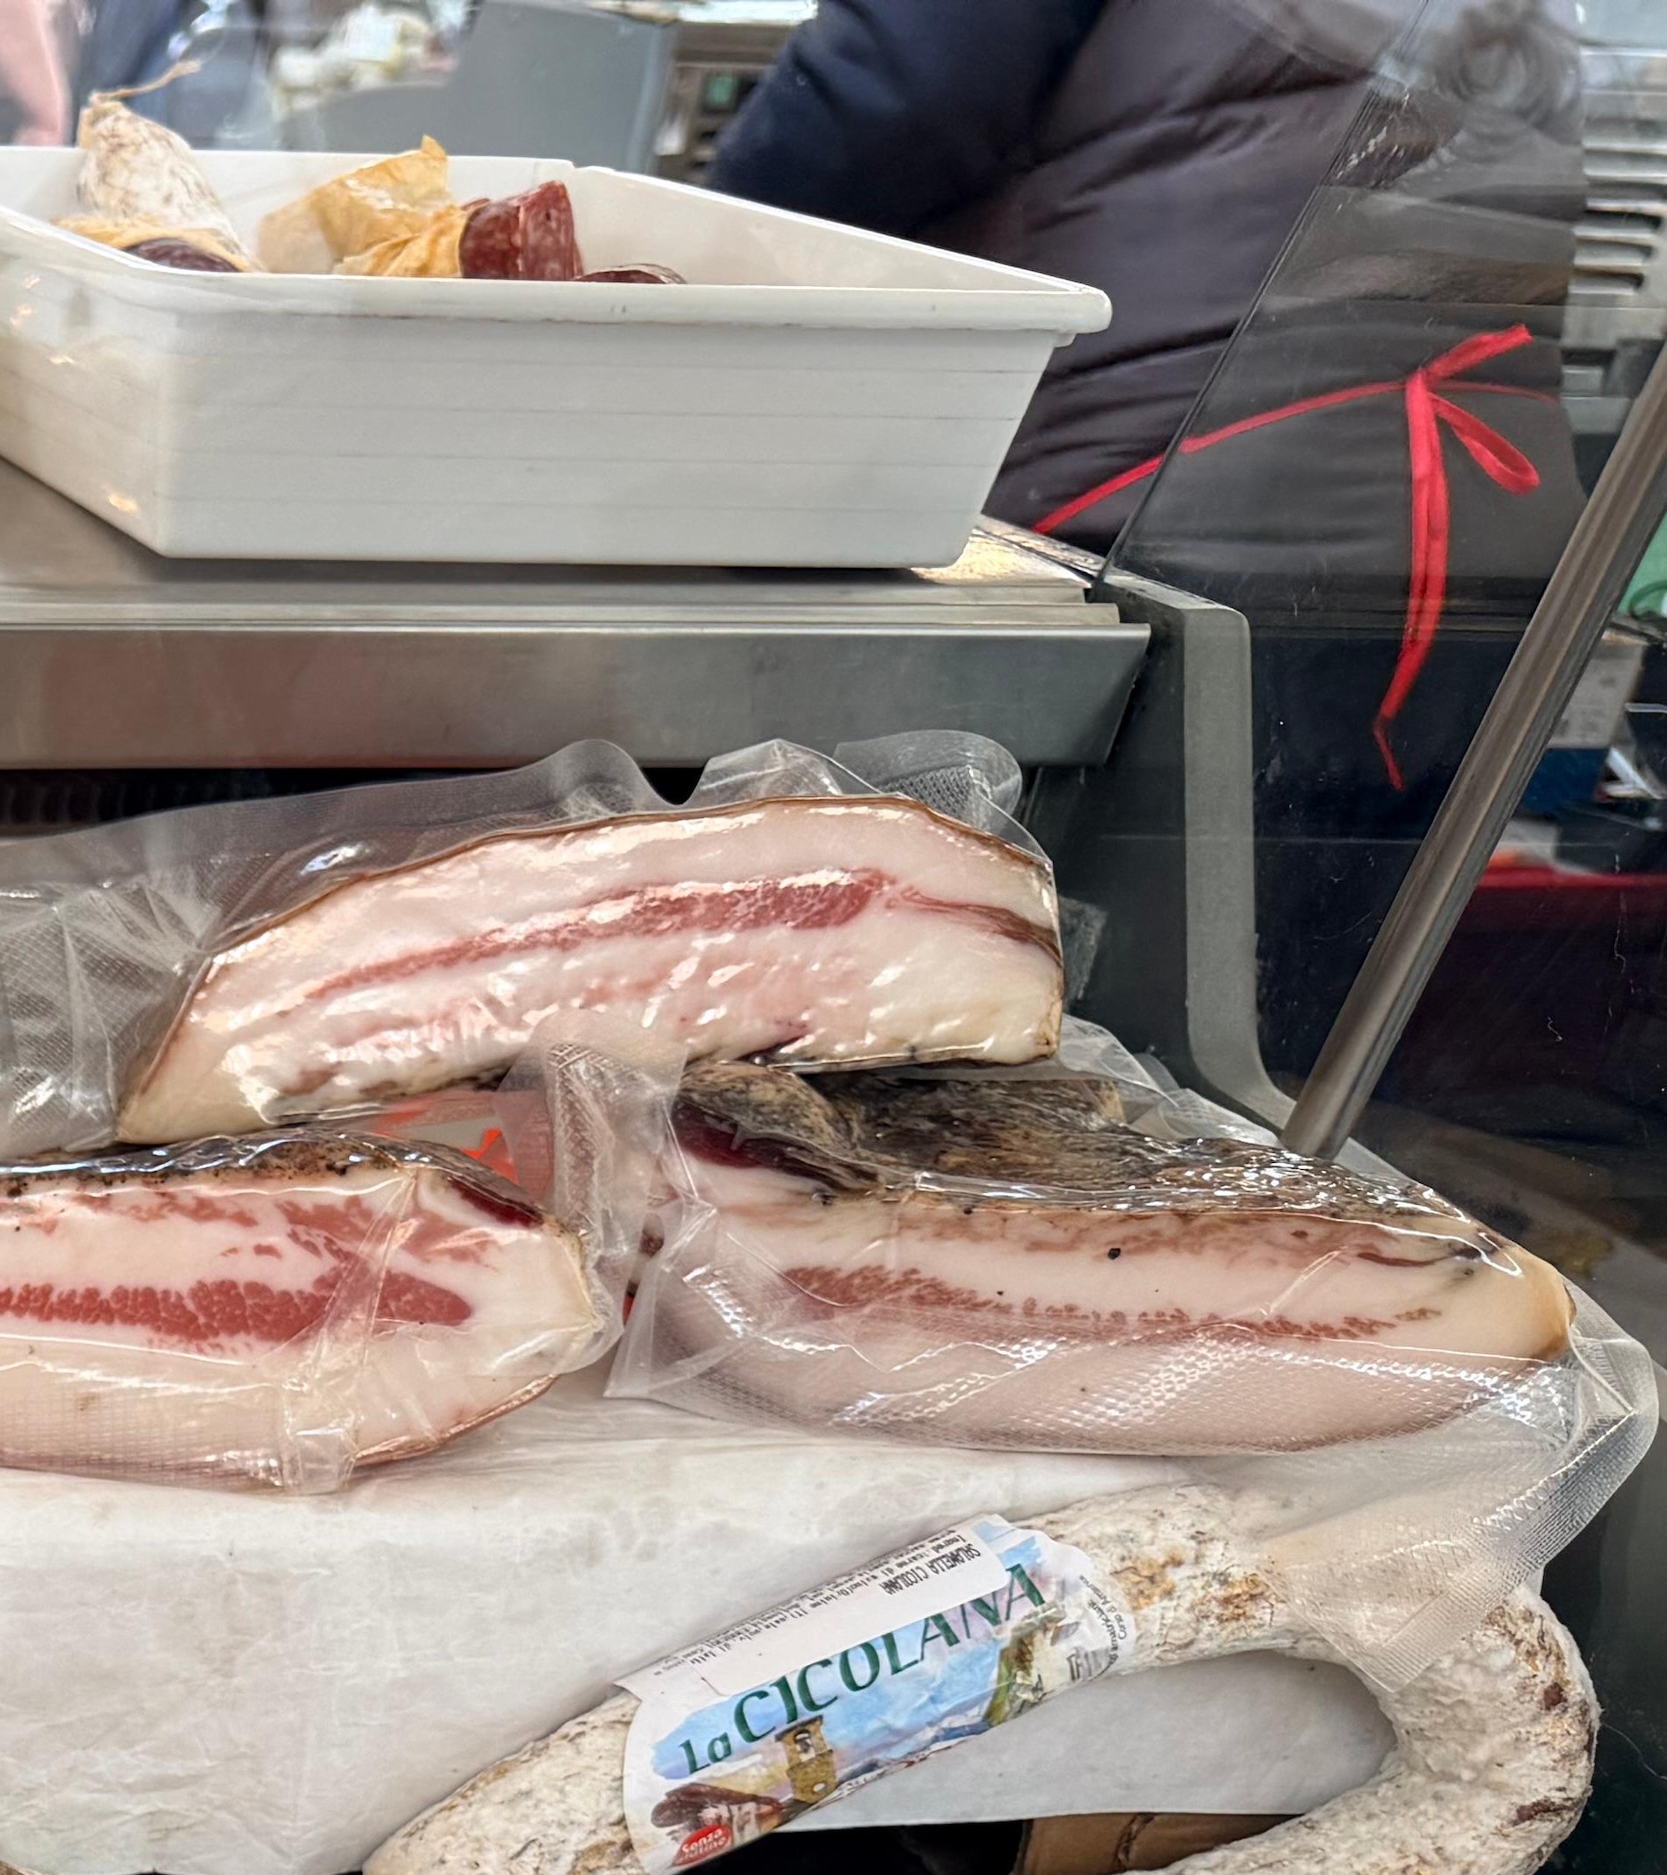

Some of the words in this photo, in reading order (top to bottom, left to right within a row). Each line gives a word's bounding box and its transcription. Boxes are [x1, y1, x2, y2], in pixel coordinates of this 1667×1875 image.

[924, 1539, 981, 1578] SALAMELLA
[879, 1564, 930, 1598] CICOLANA
[679, 1734, 733, 1777] La
[733, 1562, 1047, 1744] CICOLANA
